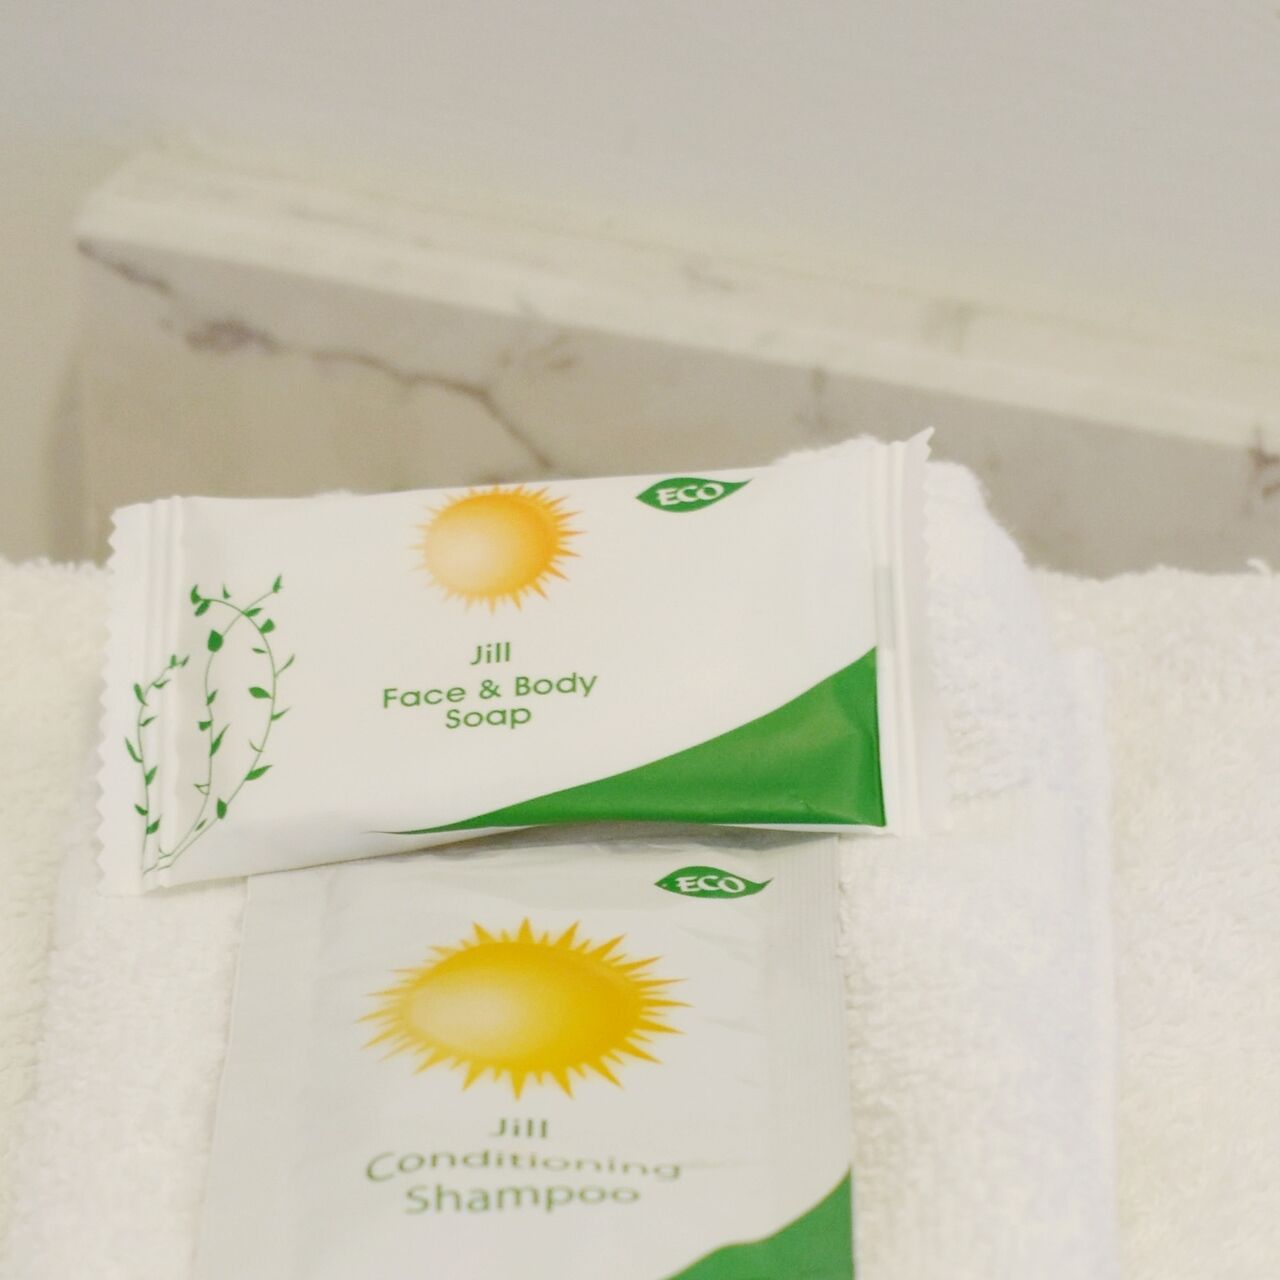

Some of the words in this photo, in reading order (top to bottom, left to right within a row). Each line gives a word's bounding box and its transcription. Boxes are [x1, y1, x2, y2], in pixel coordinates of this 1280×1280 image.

[655, 481, 725, 506] ECO
[470, 642, 511, 666] Jill
[383, 686, 467, 709] Face
[479, 679, 502, 700] &
[514, 672, 597, 698] Body
[445, 706, 532, 729] Soap
[676, 874, 746, 894] ECO
[491, 1118, 548, 1139] Jill
[366, 1150, 682, 1182] Conditioning
[406, 1184, 640, 1213] Shampoo
